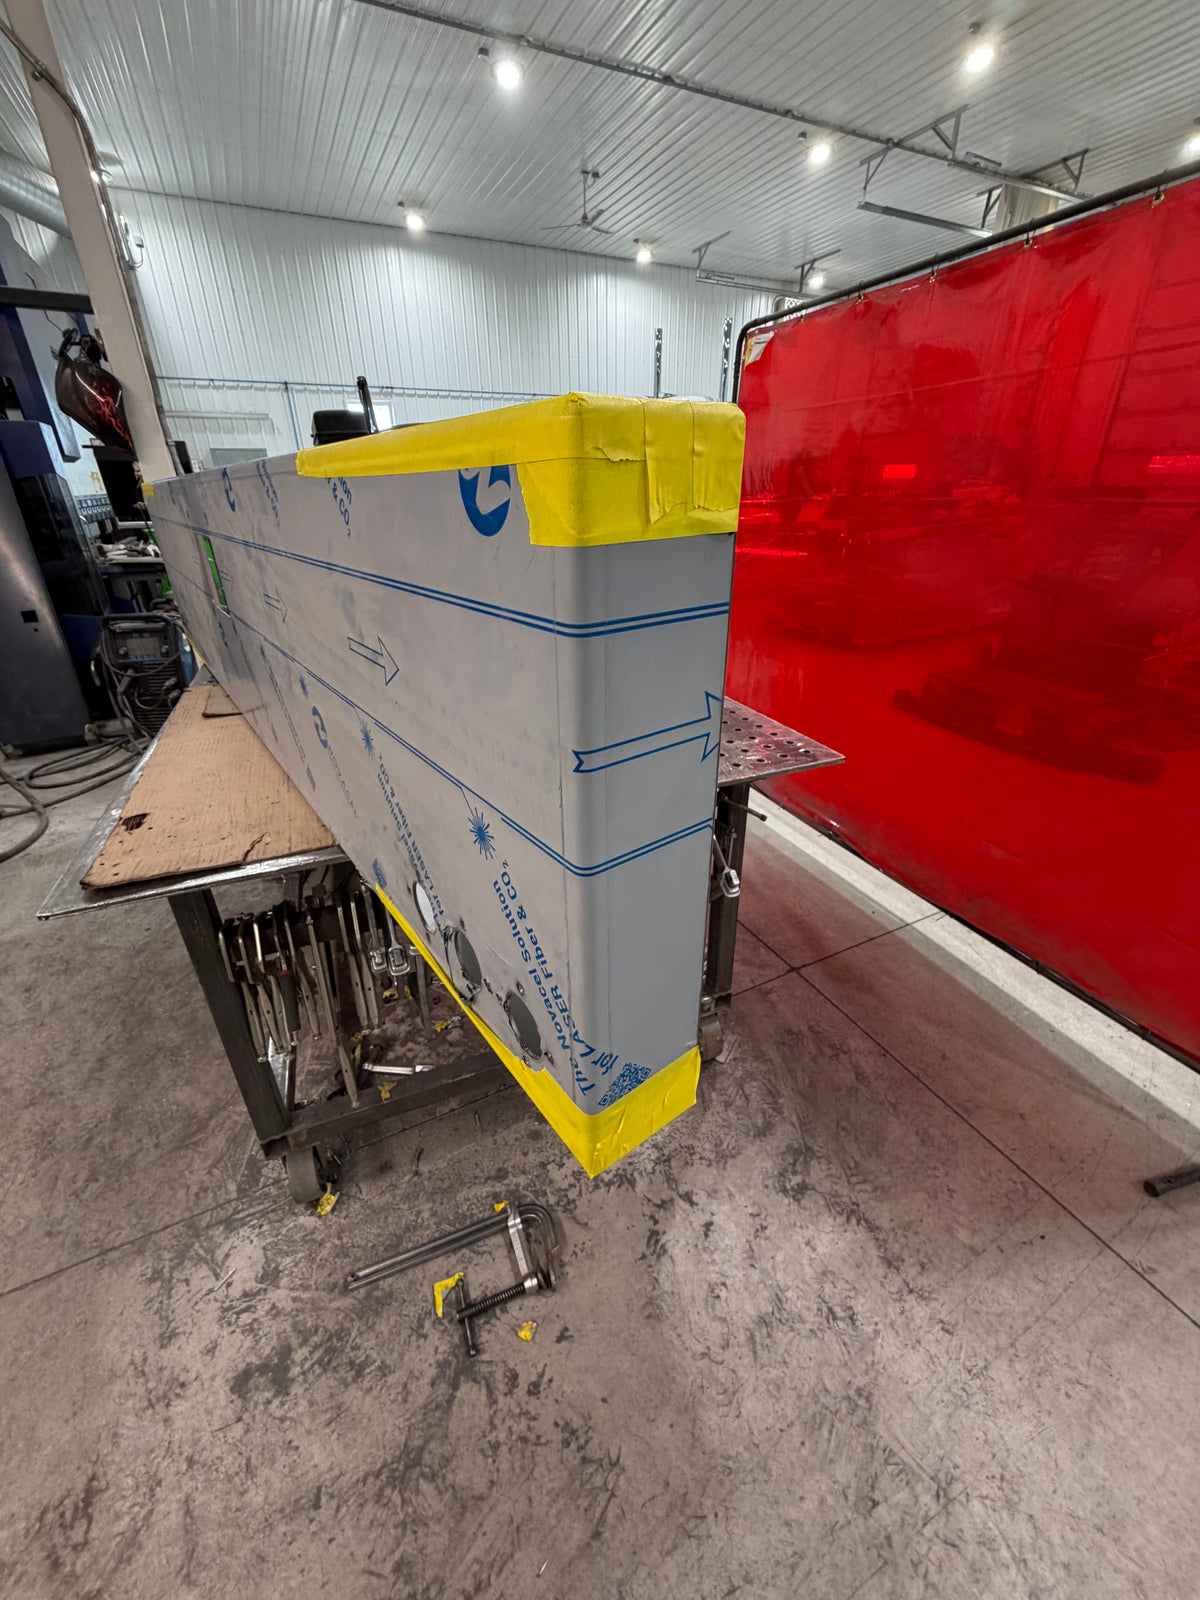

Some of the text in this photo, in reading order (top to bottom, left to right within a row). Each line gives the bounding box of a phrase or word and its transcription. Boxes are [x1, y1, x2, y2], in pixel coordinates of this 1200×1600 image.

[396, 802, 412, 838] Fiber
[412, 840, 434, 890] LASER
[432, 895, 444, 915] for
[517, 904, 527, 920] &
[525, 926, 553, 979] Fiber
[493, 880, 596, 1096] The Novacel Solution
[550, 985, 596, 1058] LASER
[591, 1051, 619, 1075] for
